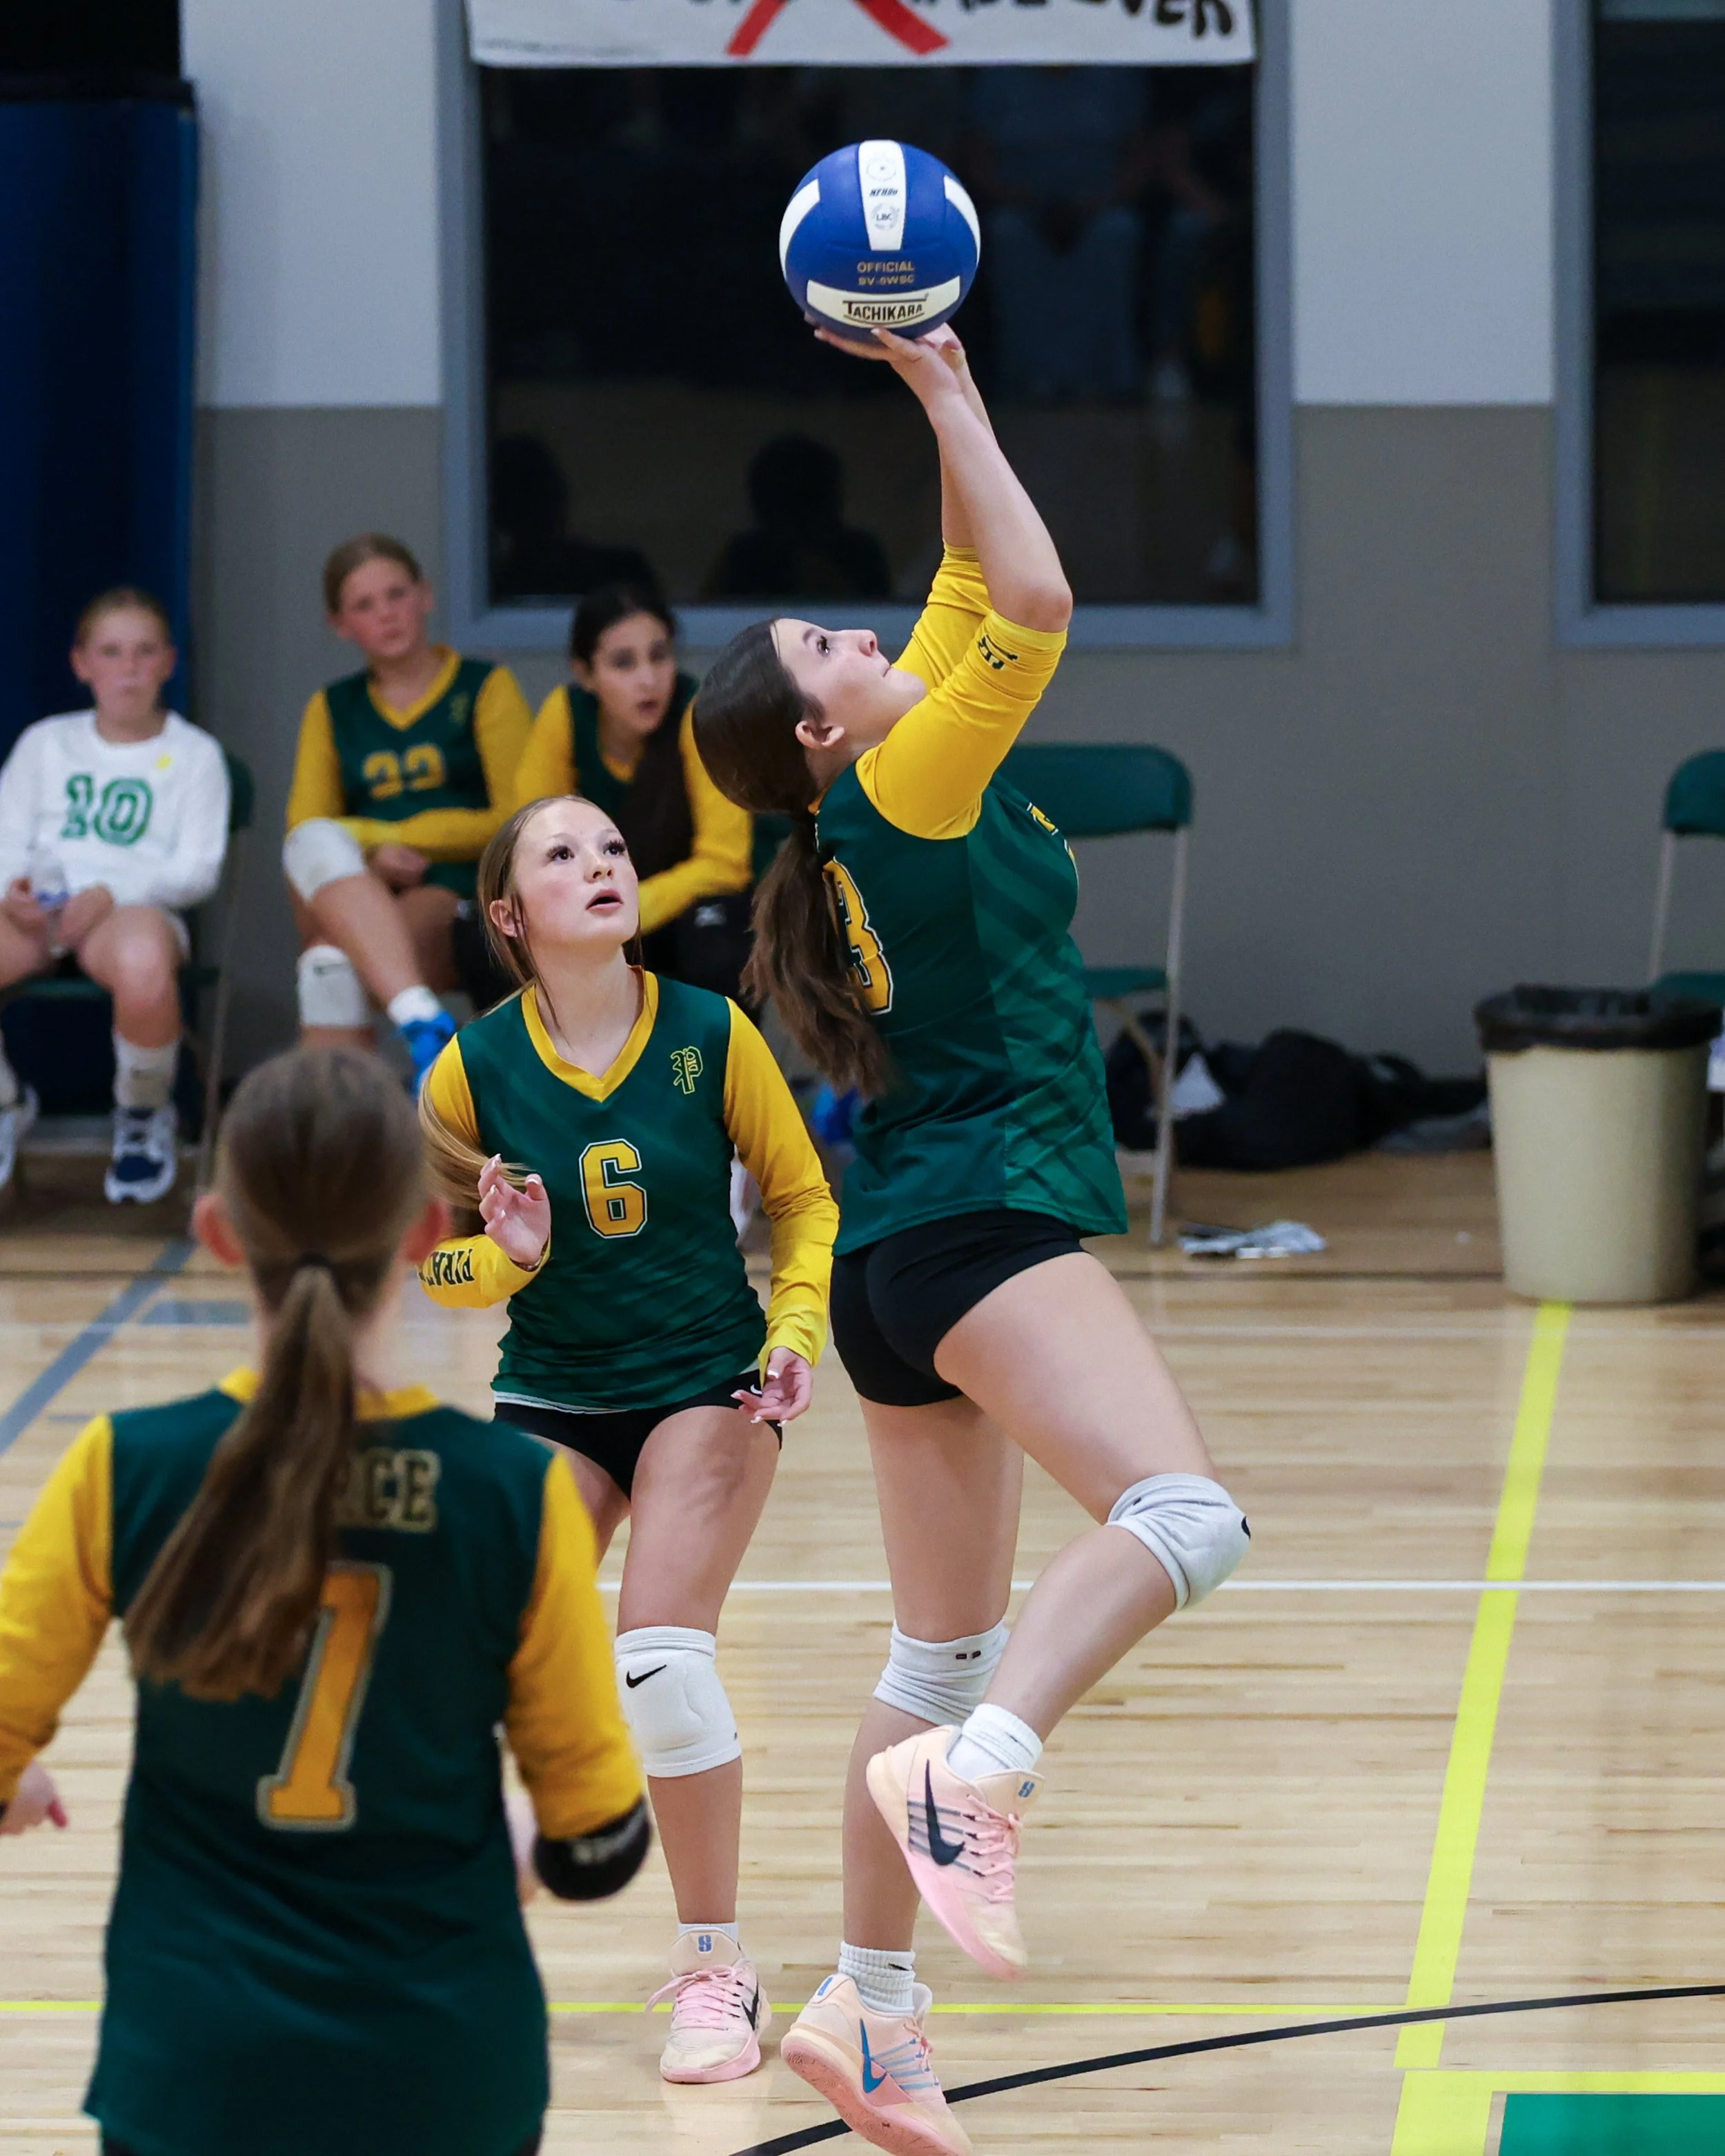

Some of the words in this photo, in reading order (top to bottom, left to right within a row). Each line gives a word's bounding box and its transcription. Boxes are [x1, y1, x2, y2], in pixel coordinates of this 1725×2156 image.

[857, 261, 914, 273] OFFICIAL
[579, 1138, 647, 1239] 6
[255, 1560, 395, 1832] 1
